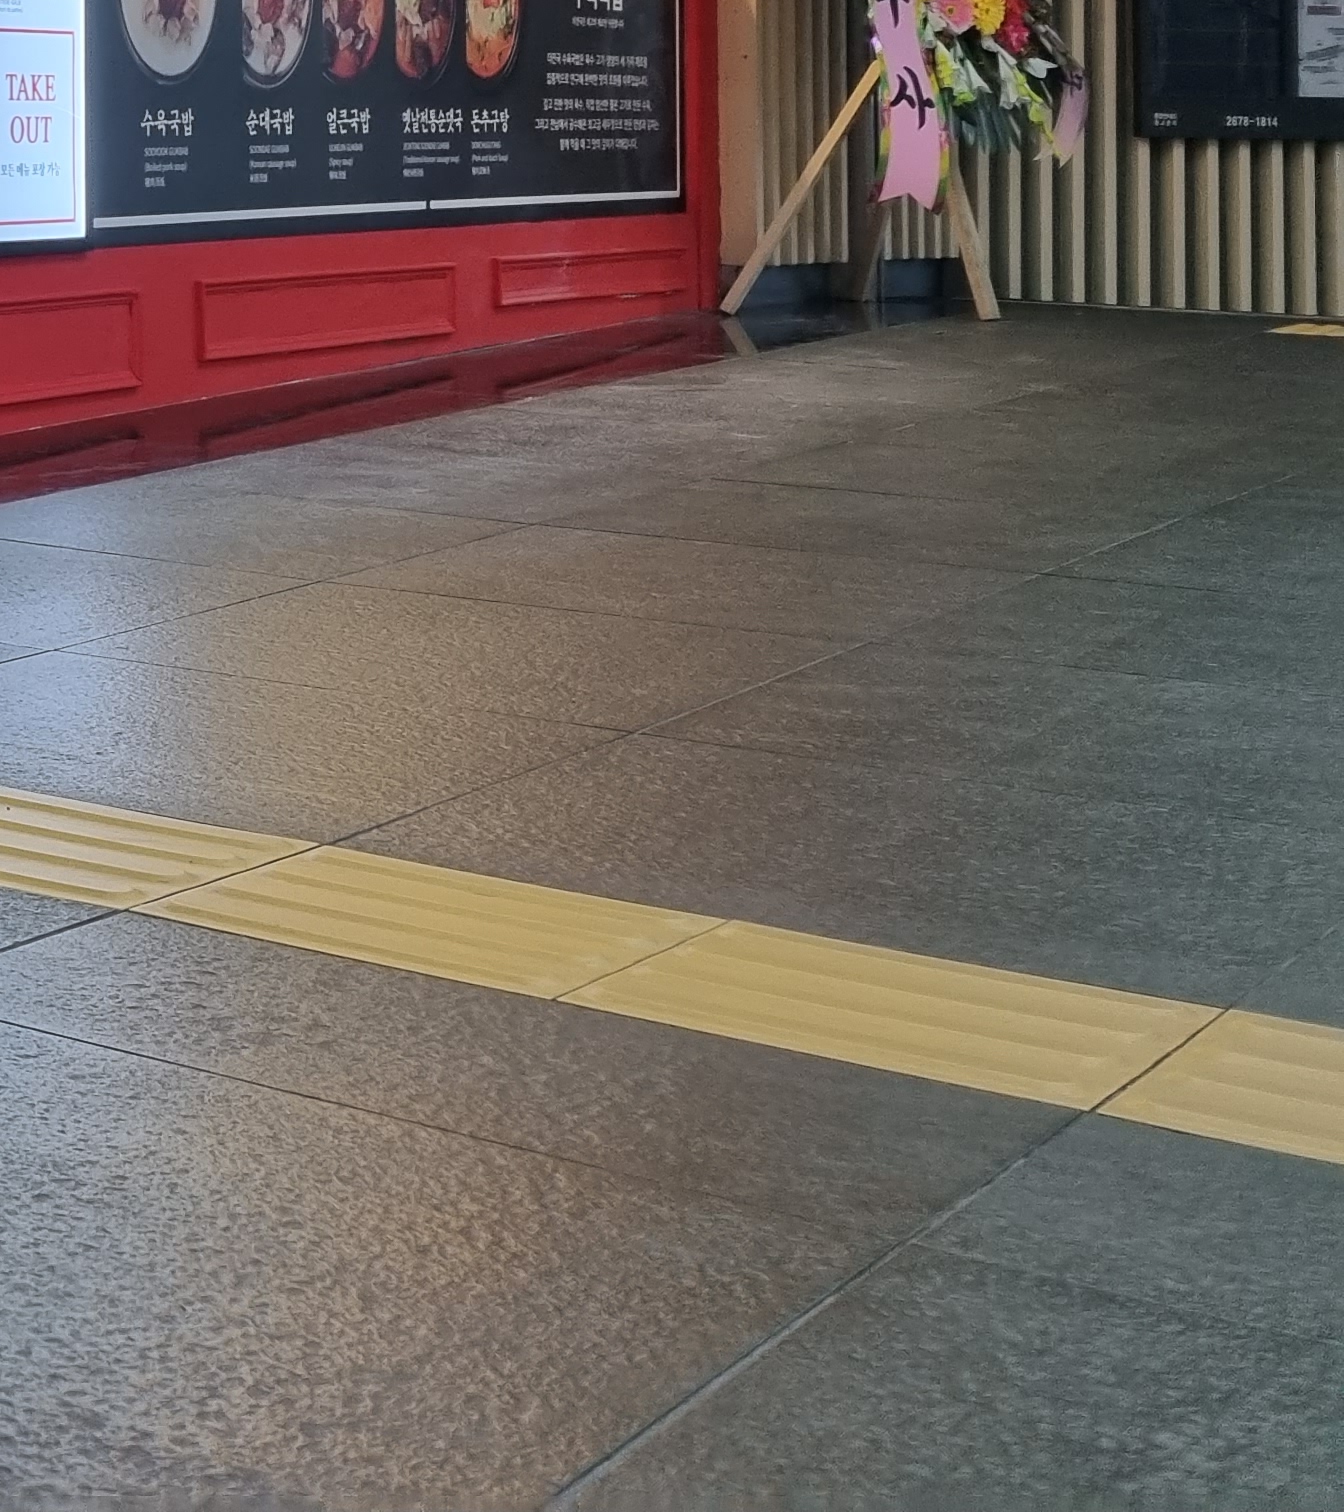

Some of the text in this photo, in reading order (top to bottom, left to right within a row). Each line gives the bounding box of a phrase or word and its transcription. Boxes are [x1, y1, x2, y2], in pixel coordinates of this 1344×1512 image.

[5, 73, 57, 102] TAKE
[10, 115, 53, 144] OUT
[140, 108, 195, 137] 수육국밥
[245, 107, 295, 136] 순대국밥
[326, 107, 371, 134] 얼큰국밥
[470, 107, 510, 134] 돈추구탕
[0, 161, 61, 178] 모든 메뉴 포장 가능
